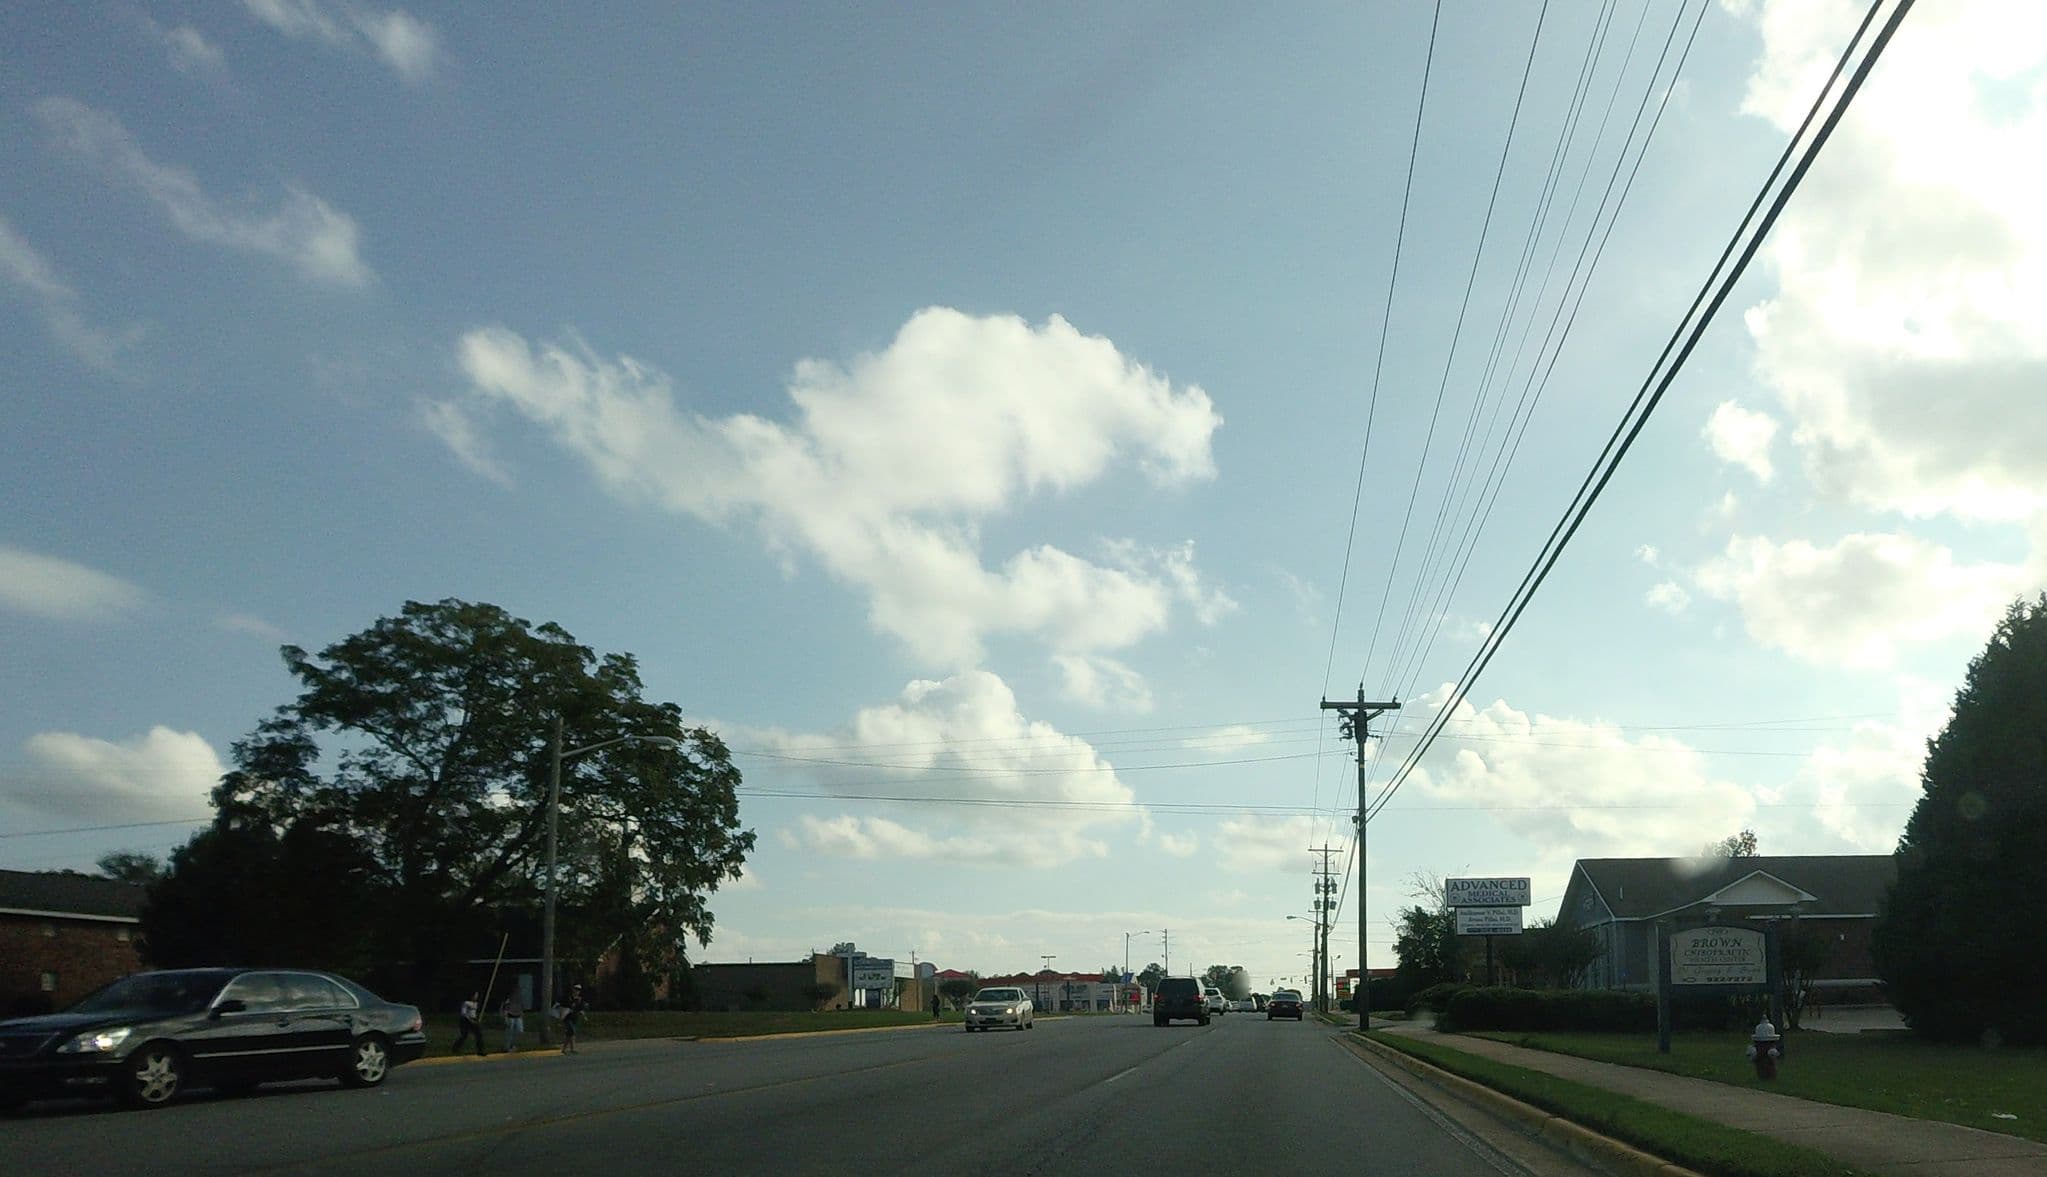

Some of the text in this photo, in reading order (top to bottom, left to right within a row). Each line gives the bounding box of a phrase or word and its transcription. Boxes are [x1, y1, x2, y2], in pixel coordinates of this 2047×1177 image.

[1450, 880, 1527, 892] ADVANCED
[1461, 896, 1517, 904] ASSOCIATES
[1692, 938, 1743, 948] BROWN
